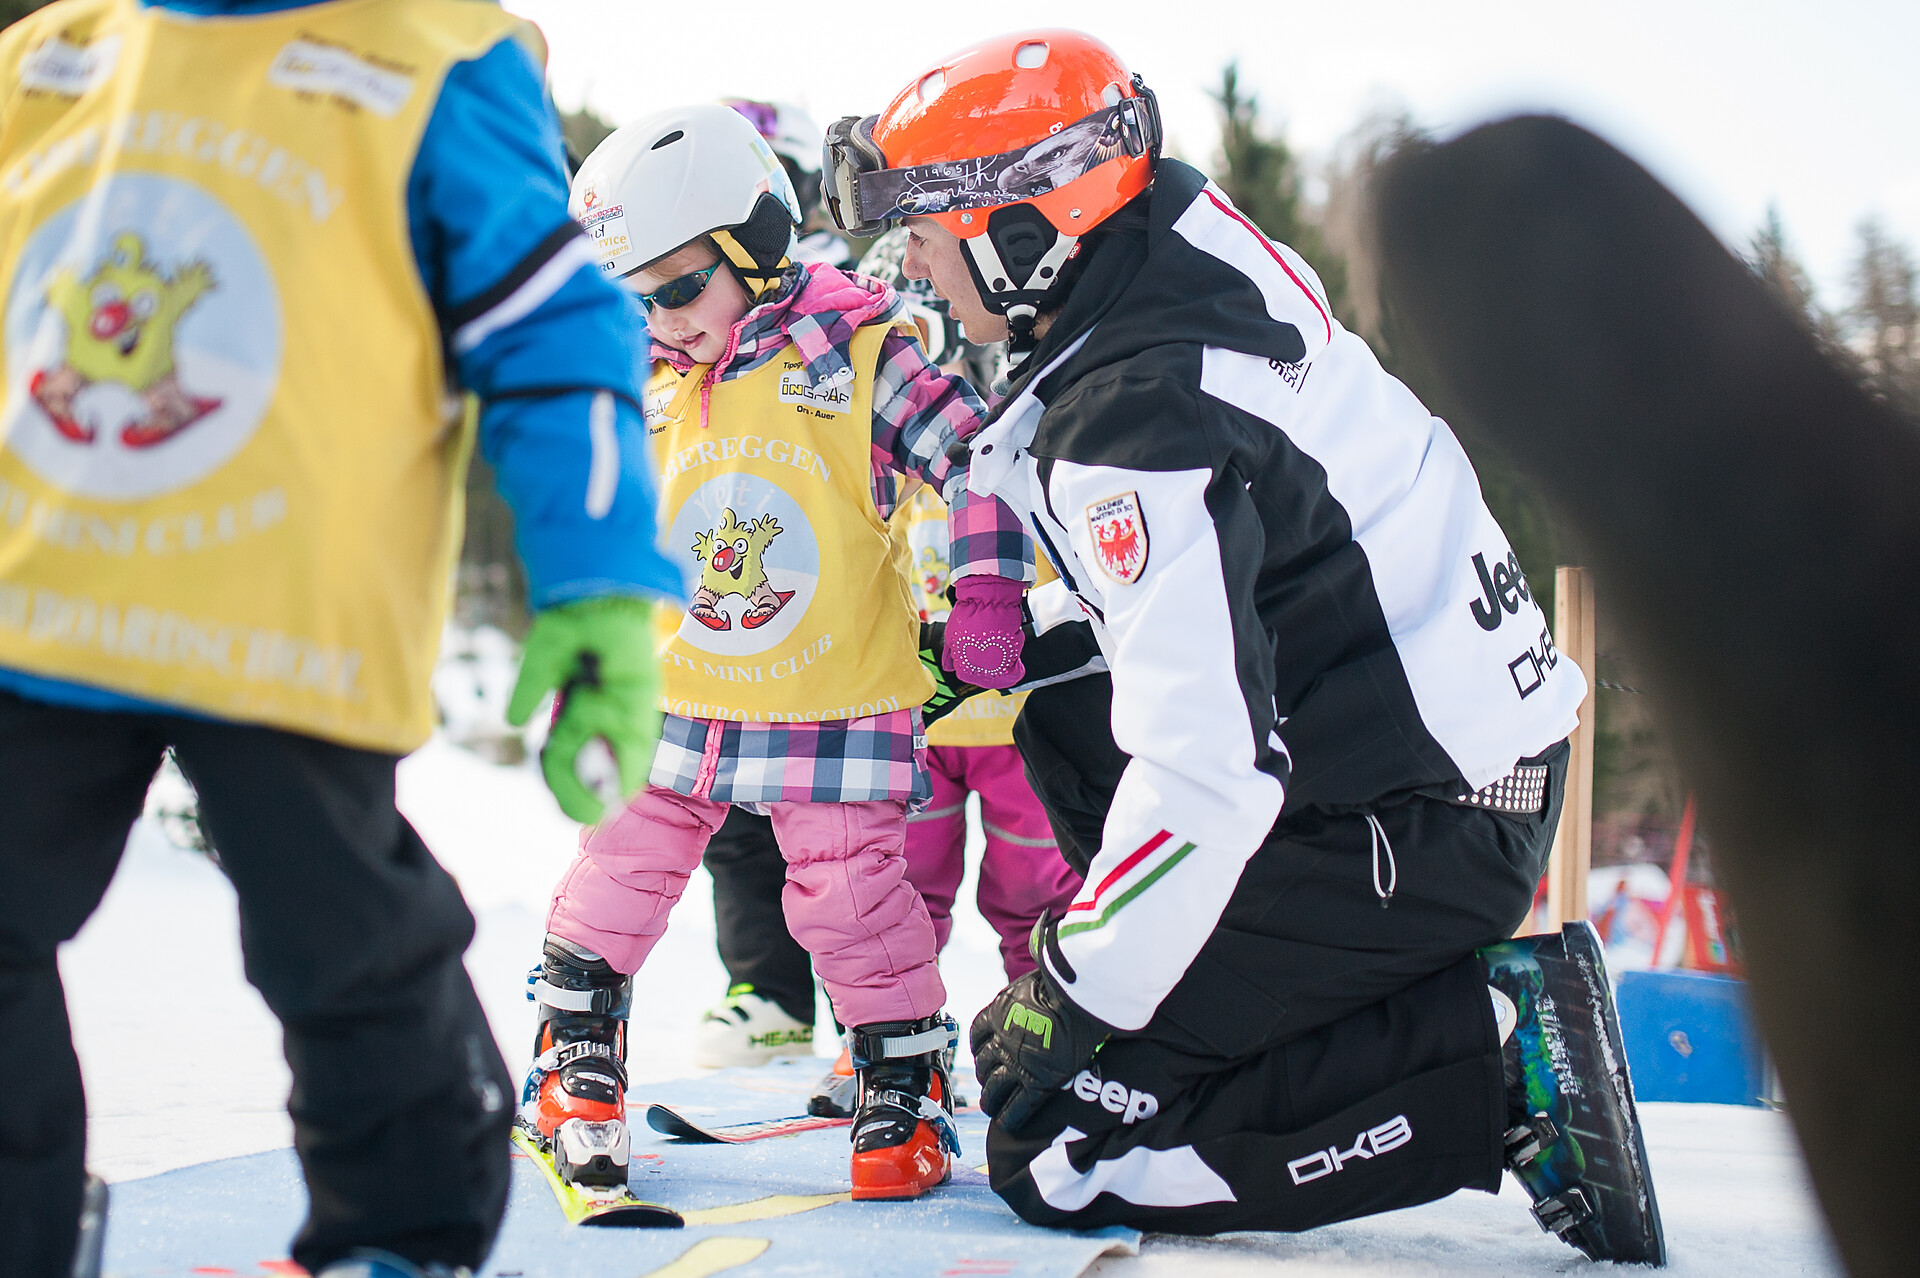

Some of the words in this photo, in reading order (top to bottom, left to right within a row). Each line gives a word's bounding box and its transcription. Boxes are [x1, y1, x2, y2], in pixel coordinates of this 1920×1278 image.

[896, 154, 998, 215] Smith
[924, 163, 963, 177] 1965
[960, 201, 973, 209] IN
[969, 187, 1009, 201] MADE
[649, 425, 667, 436] Auer
[815, 410, 836, 420] Auer
[1469, 551, 1538, 632] Jee
[703, 661, 763, 683] MINI
[770, 634, 833, 679] CLUB
[1060, 1069, 1159, 1125] eep
[1287, 1114, 1413, 1186] DKB
